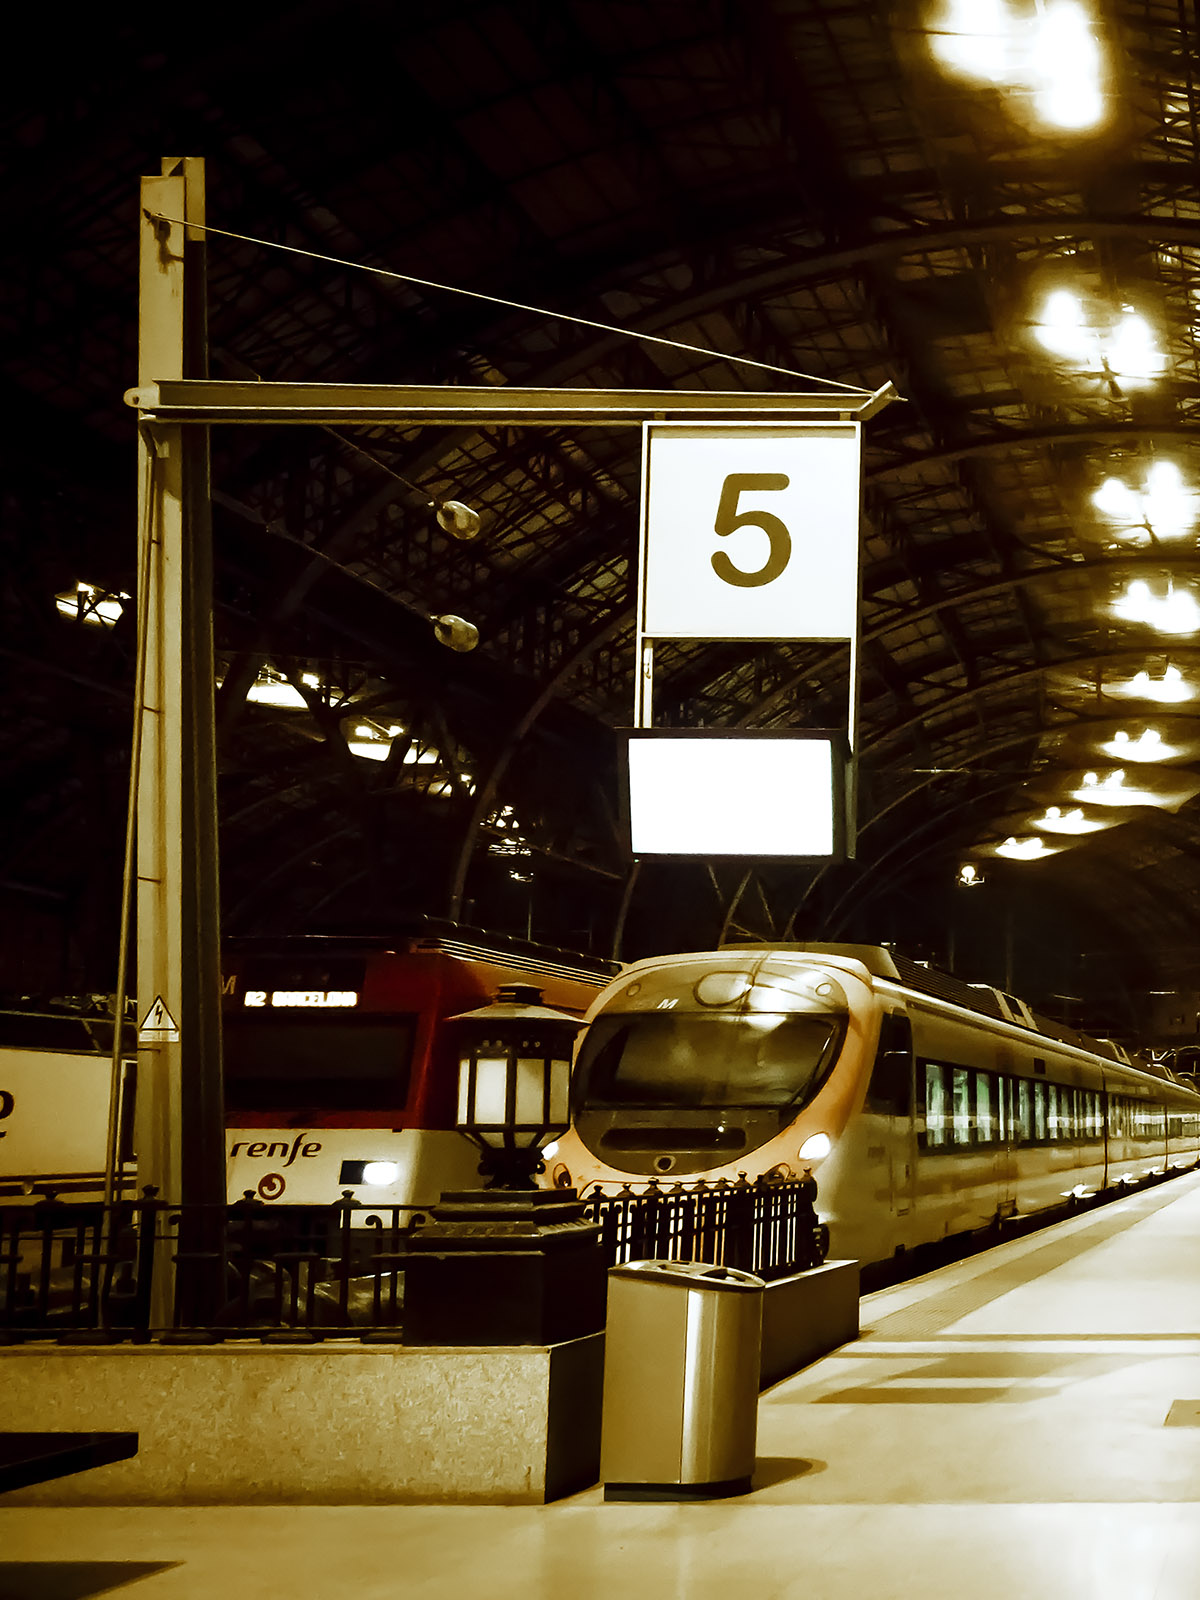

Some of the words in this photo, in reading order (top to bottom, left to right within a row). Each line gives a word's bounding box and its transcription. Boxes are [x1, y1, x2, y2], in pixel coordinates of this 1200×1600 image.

[711, 473, 792, 587] 5
[656, 998, 680, 1009] M
[230, 1133, 322, 1168] renfe
